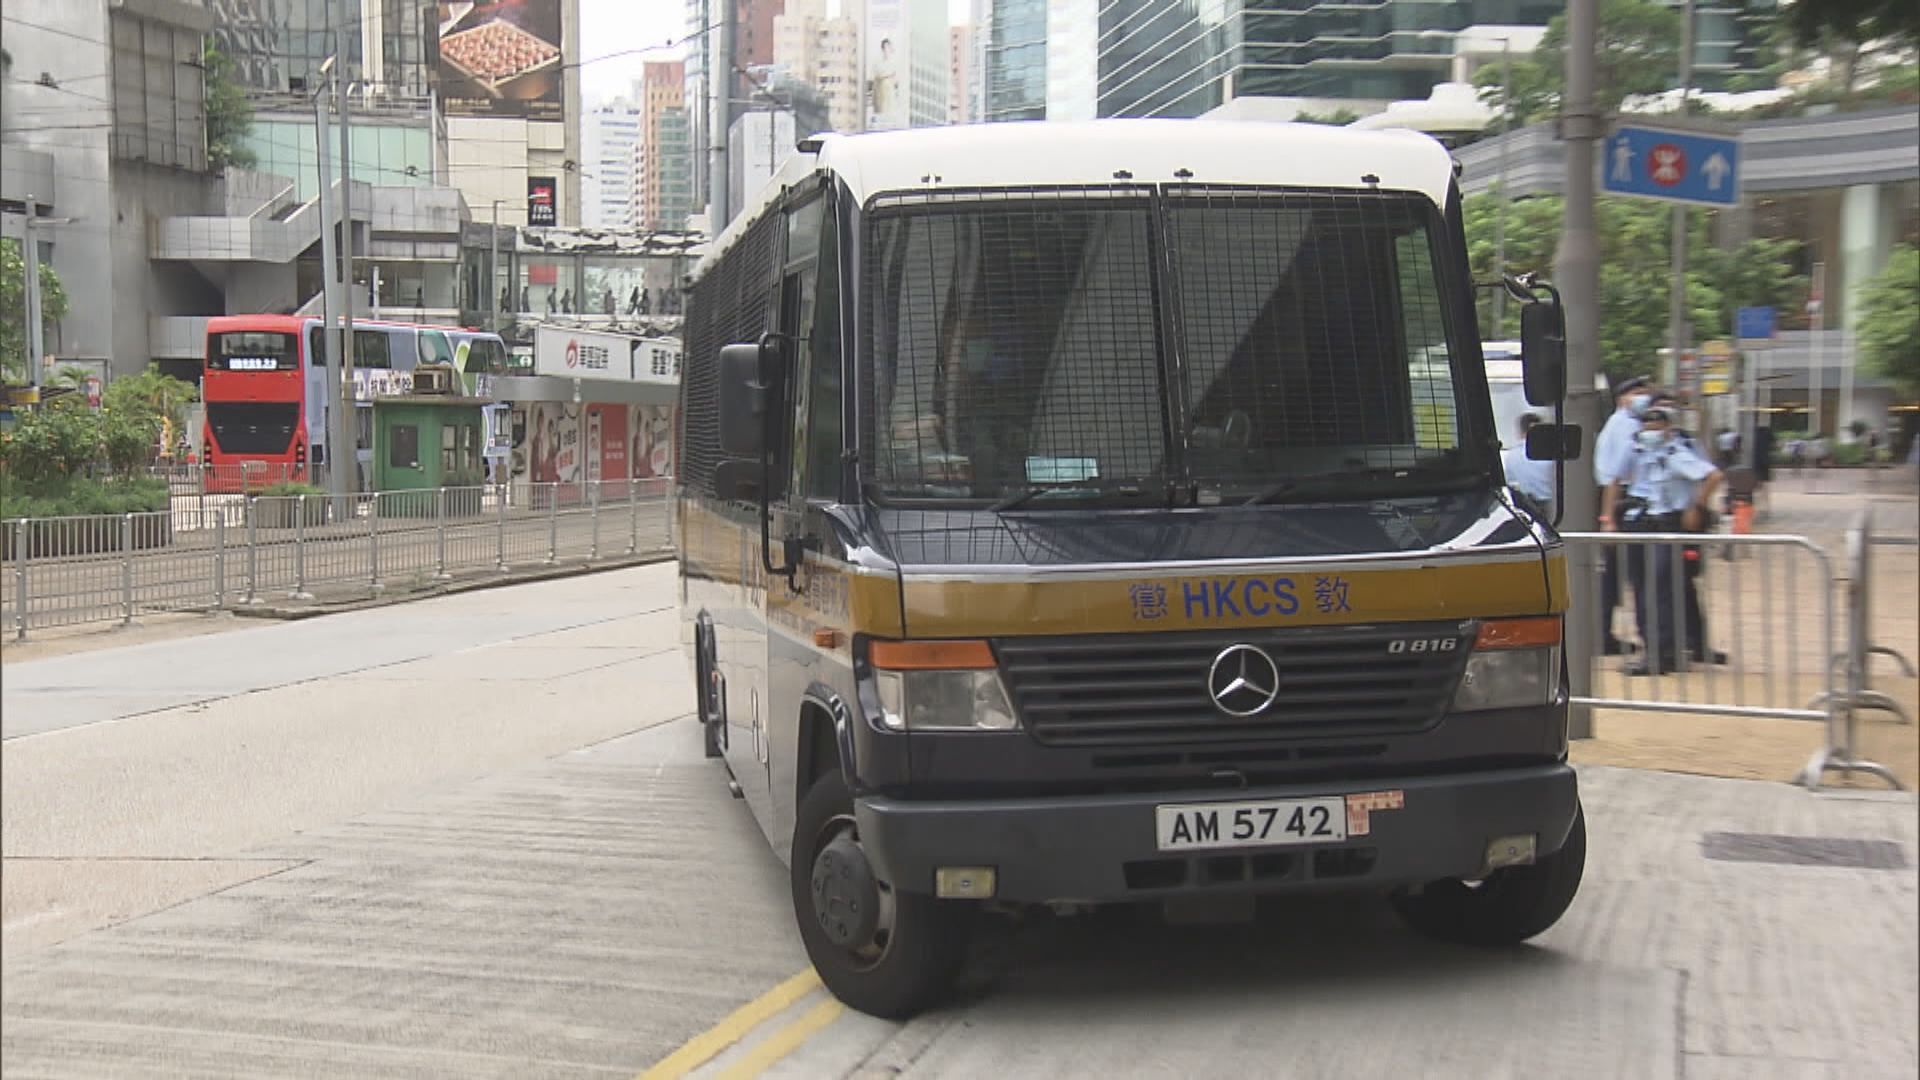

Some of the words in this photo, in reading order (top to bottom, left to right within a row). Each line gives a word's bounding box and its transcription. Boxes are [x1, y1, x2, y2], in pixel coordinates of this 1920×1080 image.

[1128, 583, 1169, 619] 懲
[1183, 577, 1299, 618] HKCS
[1410, 637, 1457, 652] 816
[1170, 810, 1220, 844] AM
[1232, 805, 1333, 840] 5742
